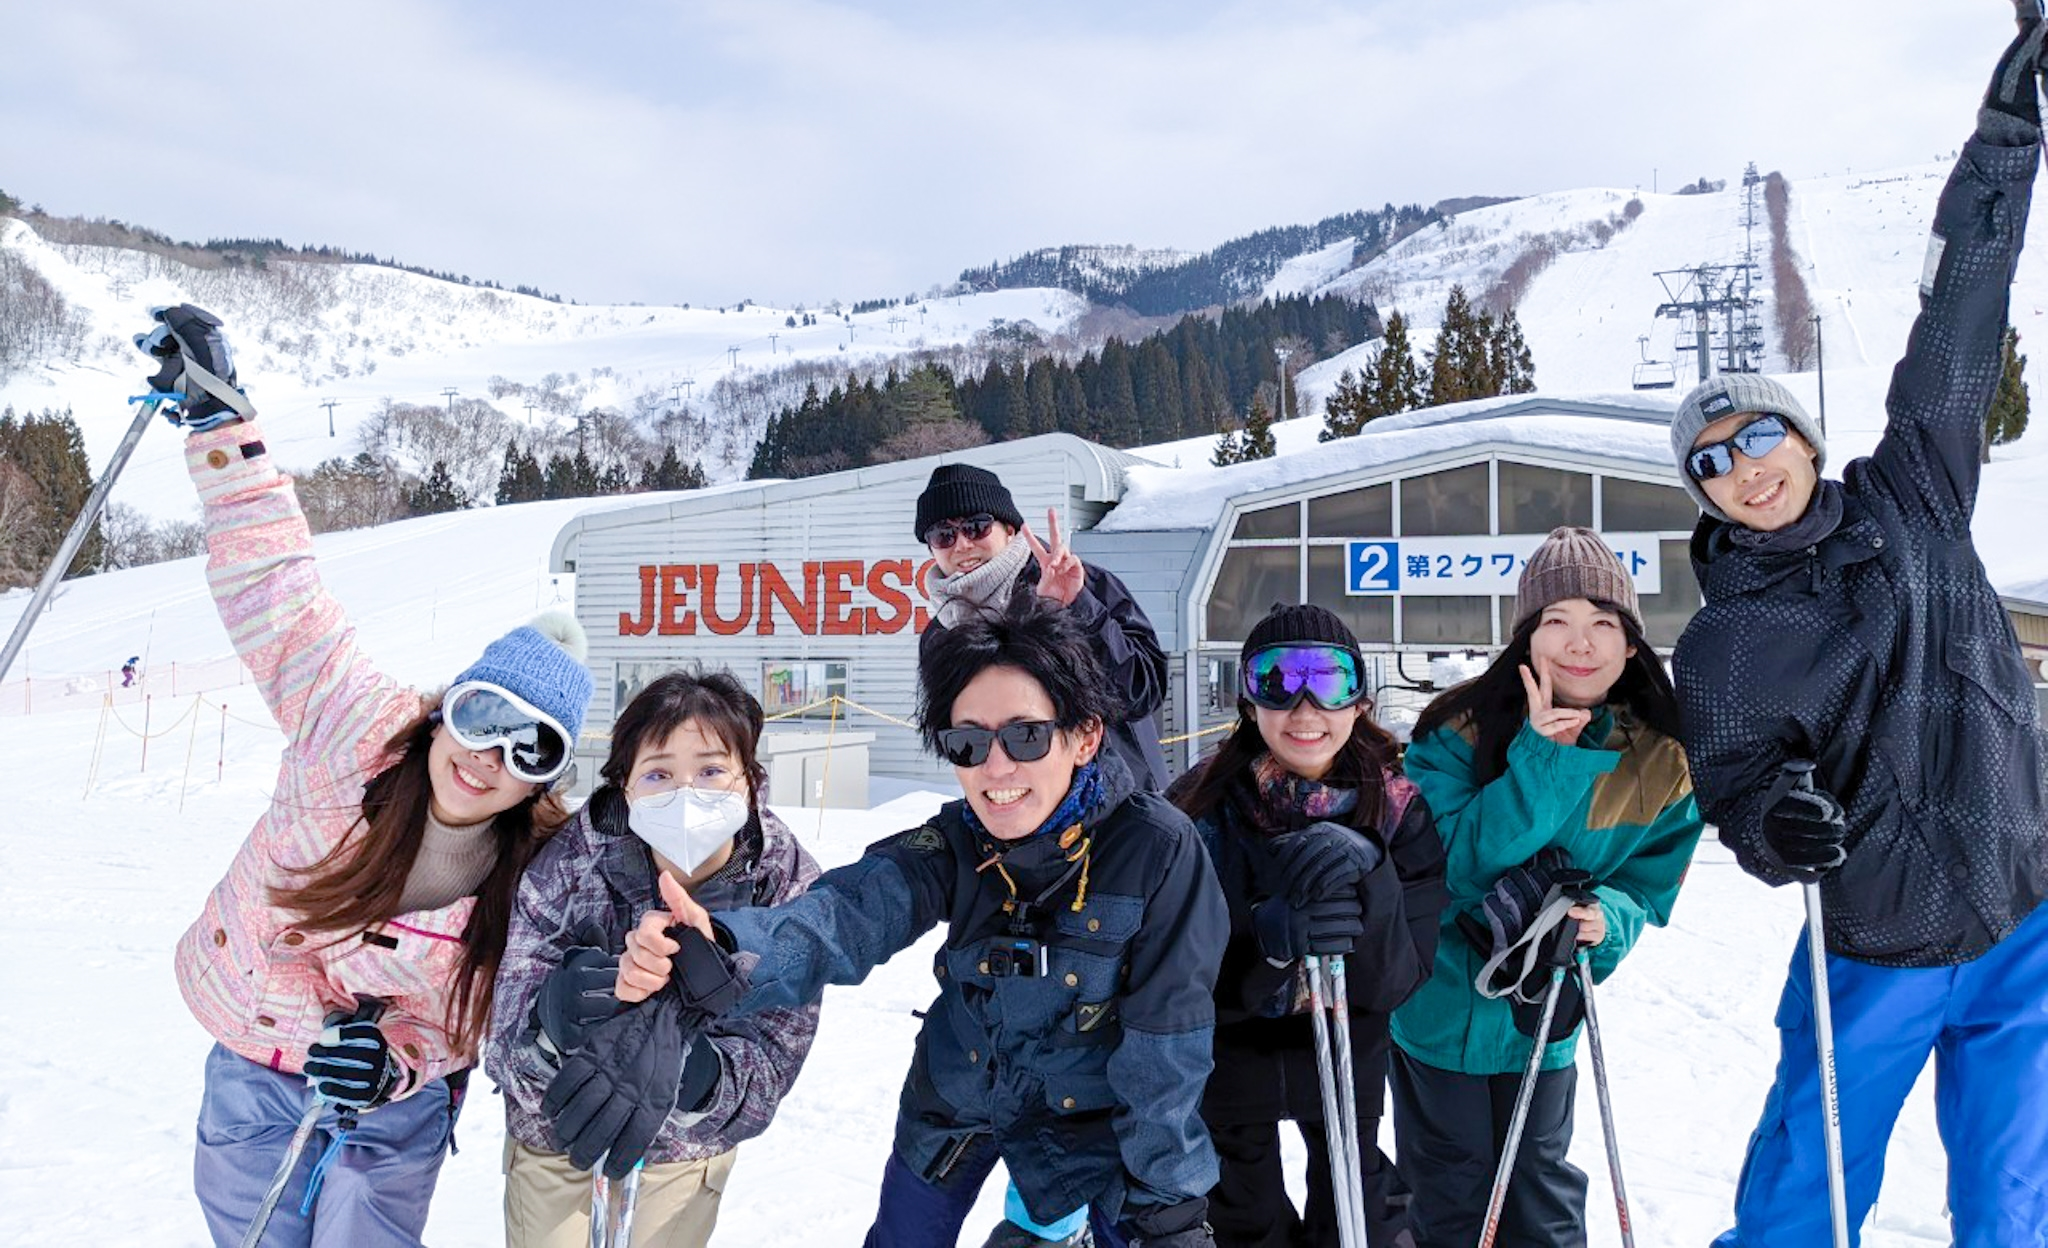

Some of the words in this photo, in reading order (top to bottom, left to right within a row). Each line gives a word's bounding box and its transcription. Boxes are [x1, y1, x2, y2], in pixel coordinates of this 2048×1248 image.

[1359, 544, 1390, 590] 2
[1406, 550, 1648, 578] 第2クワト
